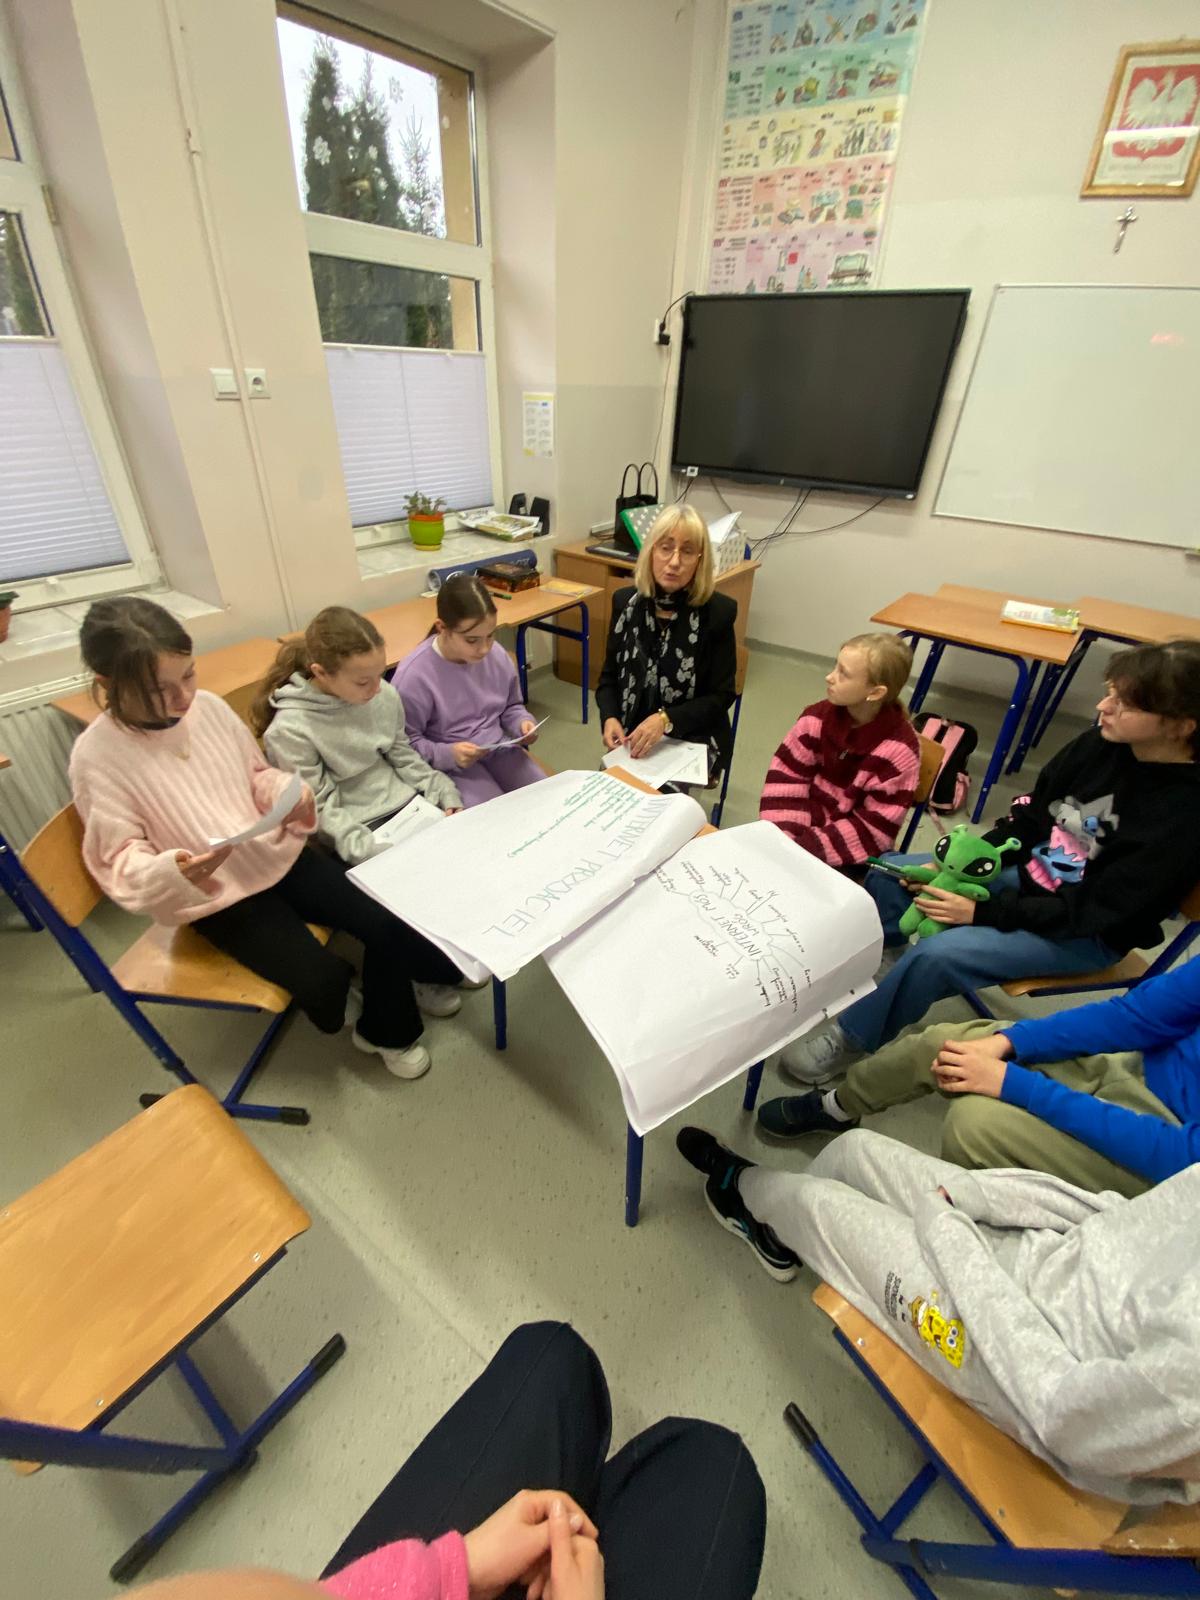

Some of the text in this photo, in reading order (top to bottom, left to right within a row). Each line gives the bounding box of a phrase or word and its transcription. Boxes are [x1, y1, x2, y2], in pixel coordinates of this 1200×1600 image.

[728, 71, 741, 84] kg
[598, 798, 672, 860] INTERNET
[711, 915, 763, 957] INTERNET
